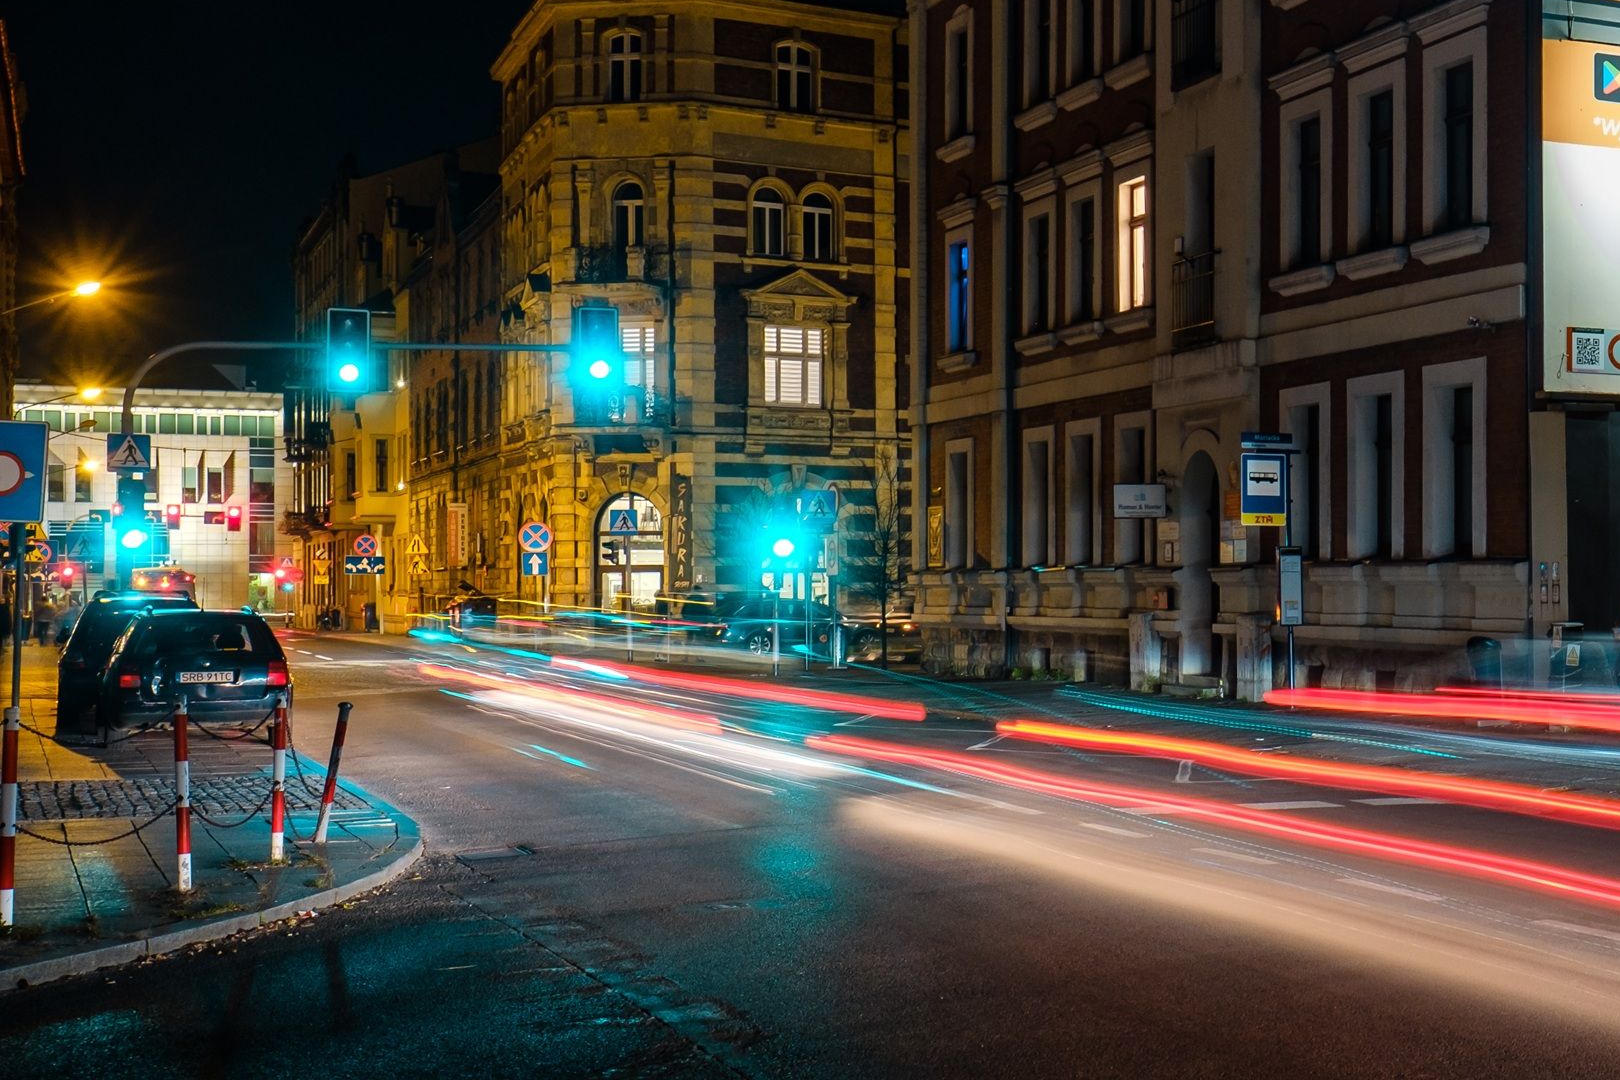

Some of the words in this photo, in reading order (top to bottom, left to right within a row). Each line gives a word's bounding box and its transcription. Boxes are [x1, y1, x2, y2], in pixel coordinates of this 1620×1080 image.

[676, 482, 687, 577] SAKURA
[182, 672, 204, 682] SRB
[206, 672, 232, 681] 91TC
